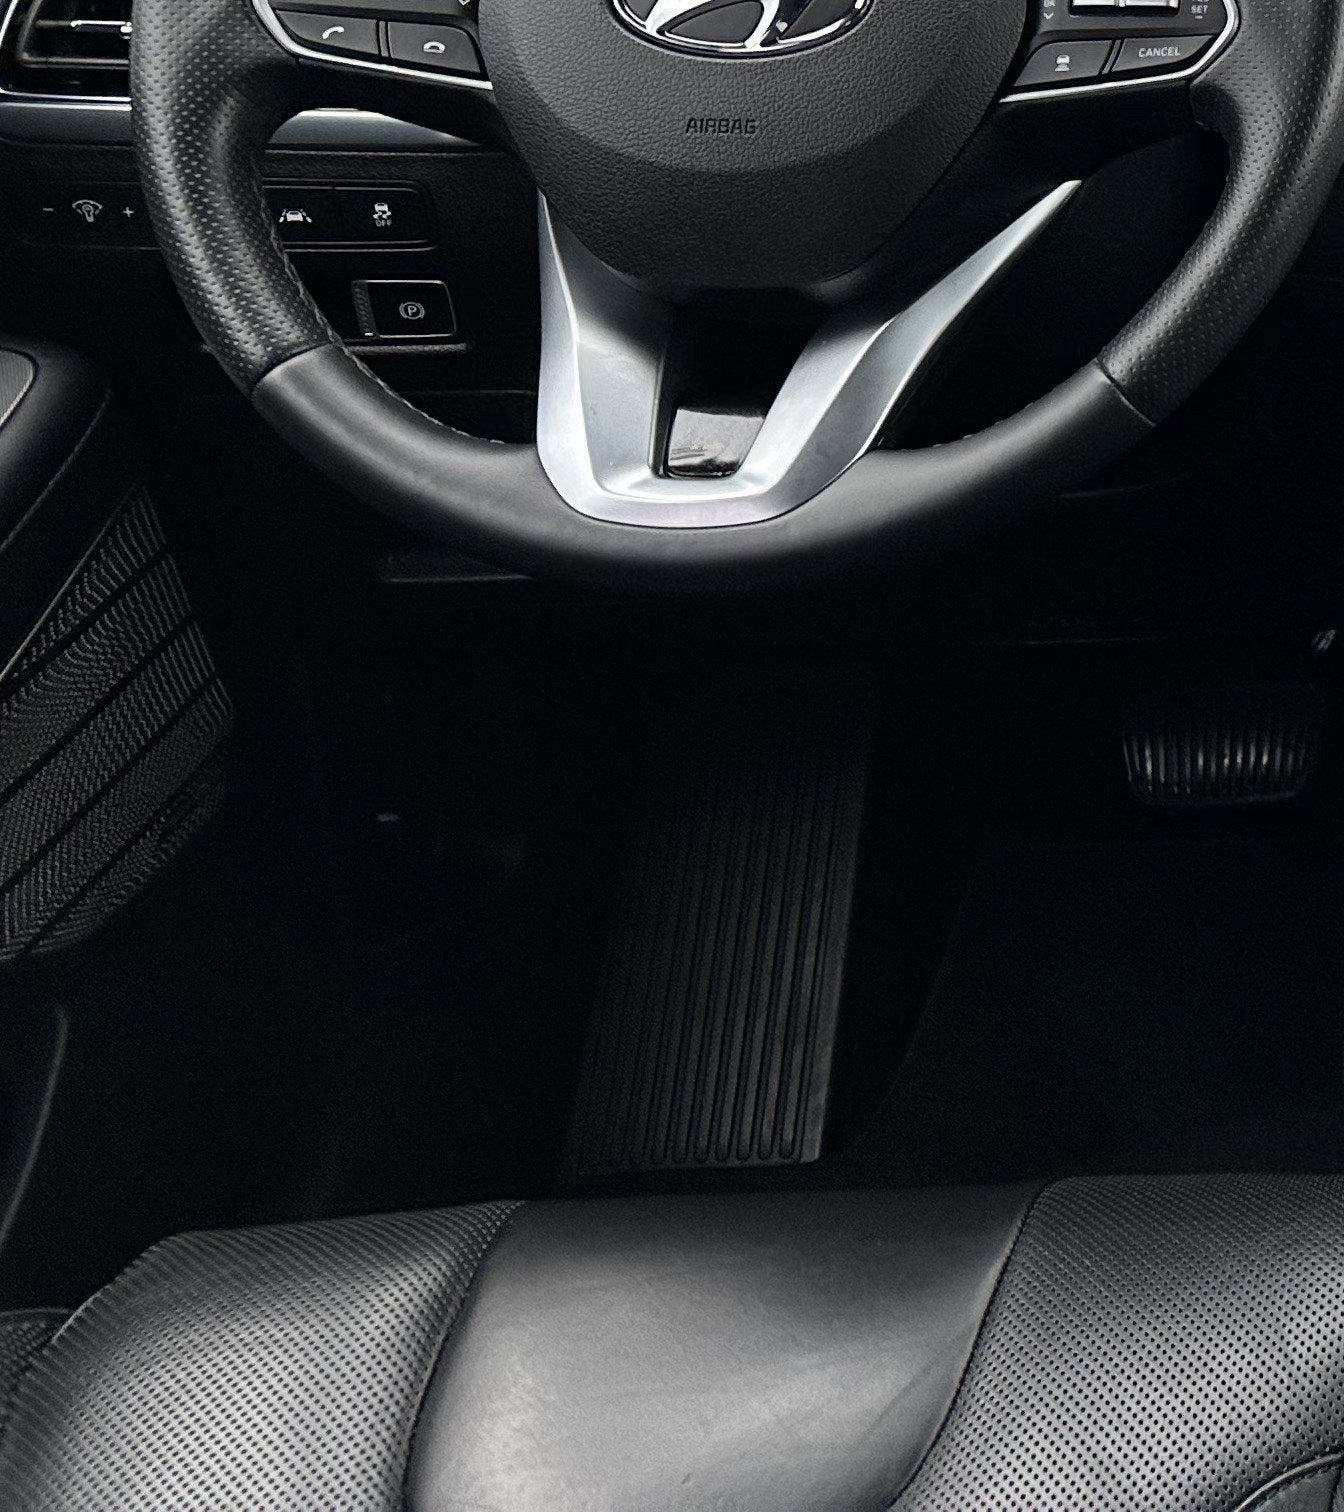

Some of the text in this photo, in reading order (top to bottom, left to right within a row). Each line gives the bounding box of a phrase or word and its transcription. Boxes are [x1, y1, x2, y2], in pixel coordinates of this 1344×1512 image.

[1190, 4, 1208, 15] SET
[1137, 46, 1181, 59] CANCEL
[685, 117, 757, 135] AIRBAG
